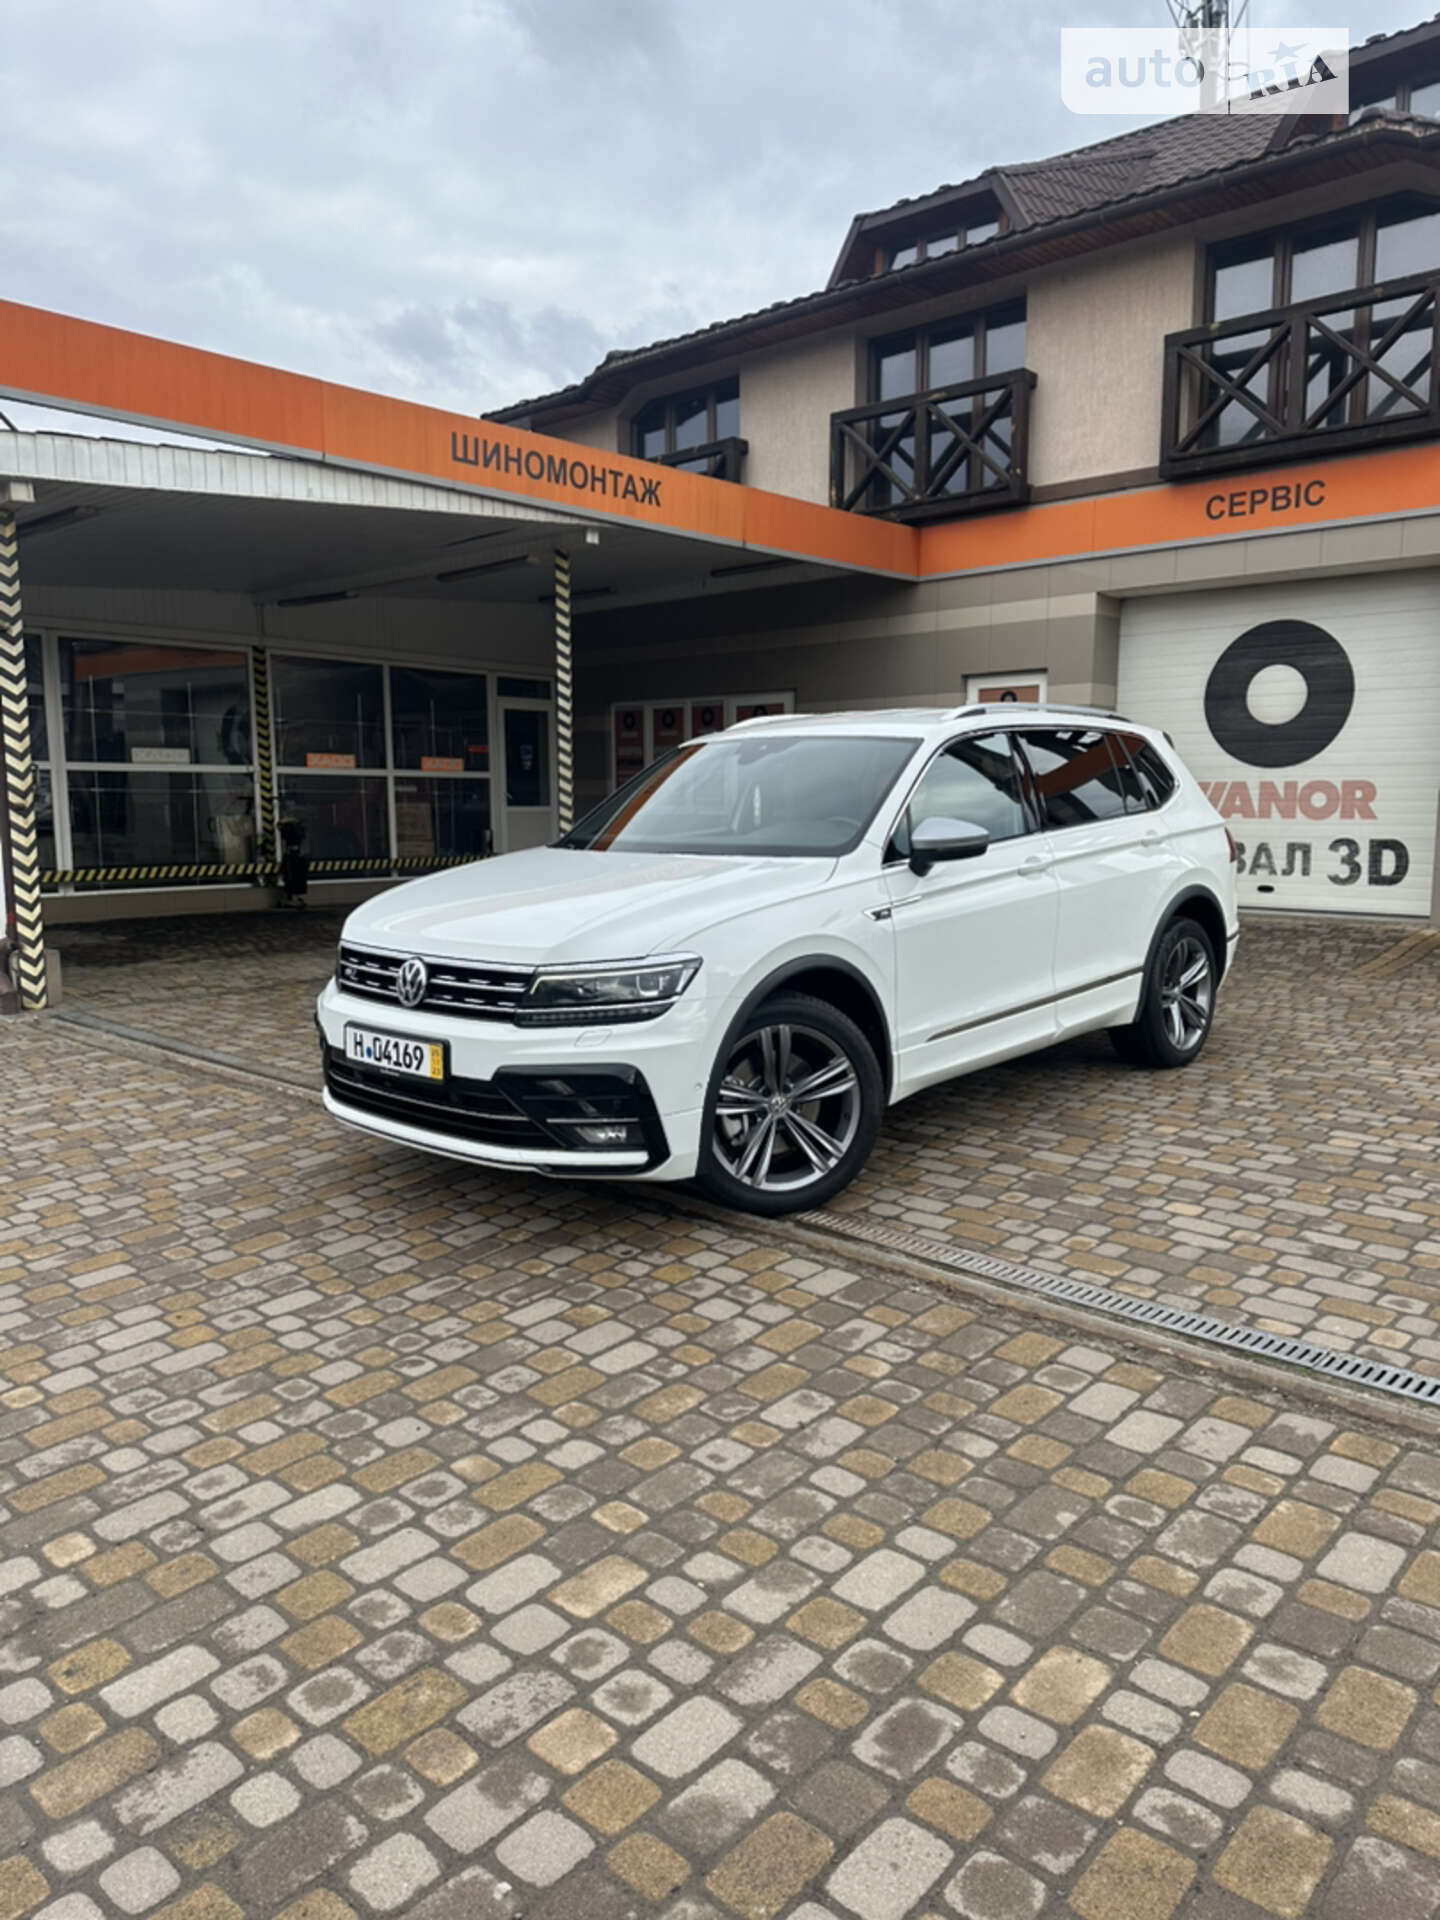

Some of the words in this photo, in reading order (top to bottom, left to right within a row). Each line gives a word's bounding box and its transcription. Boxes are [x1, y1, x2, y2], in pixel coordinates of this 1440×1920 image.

[451, 431, 662, 507] ШИНОМОНТАЖ
[1206, 480, 1326, 520] СЕРВІС
[1327, 837, 1410, 886] 3D
[353, 1032, 365, 1058] H
[373, 1037, 424, 1071] 04169
